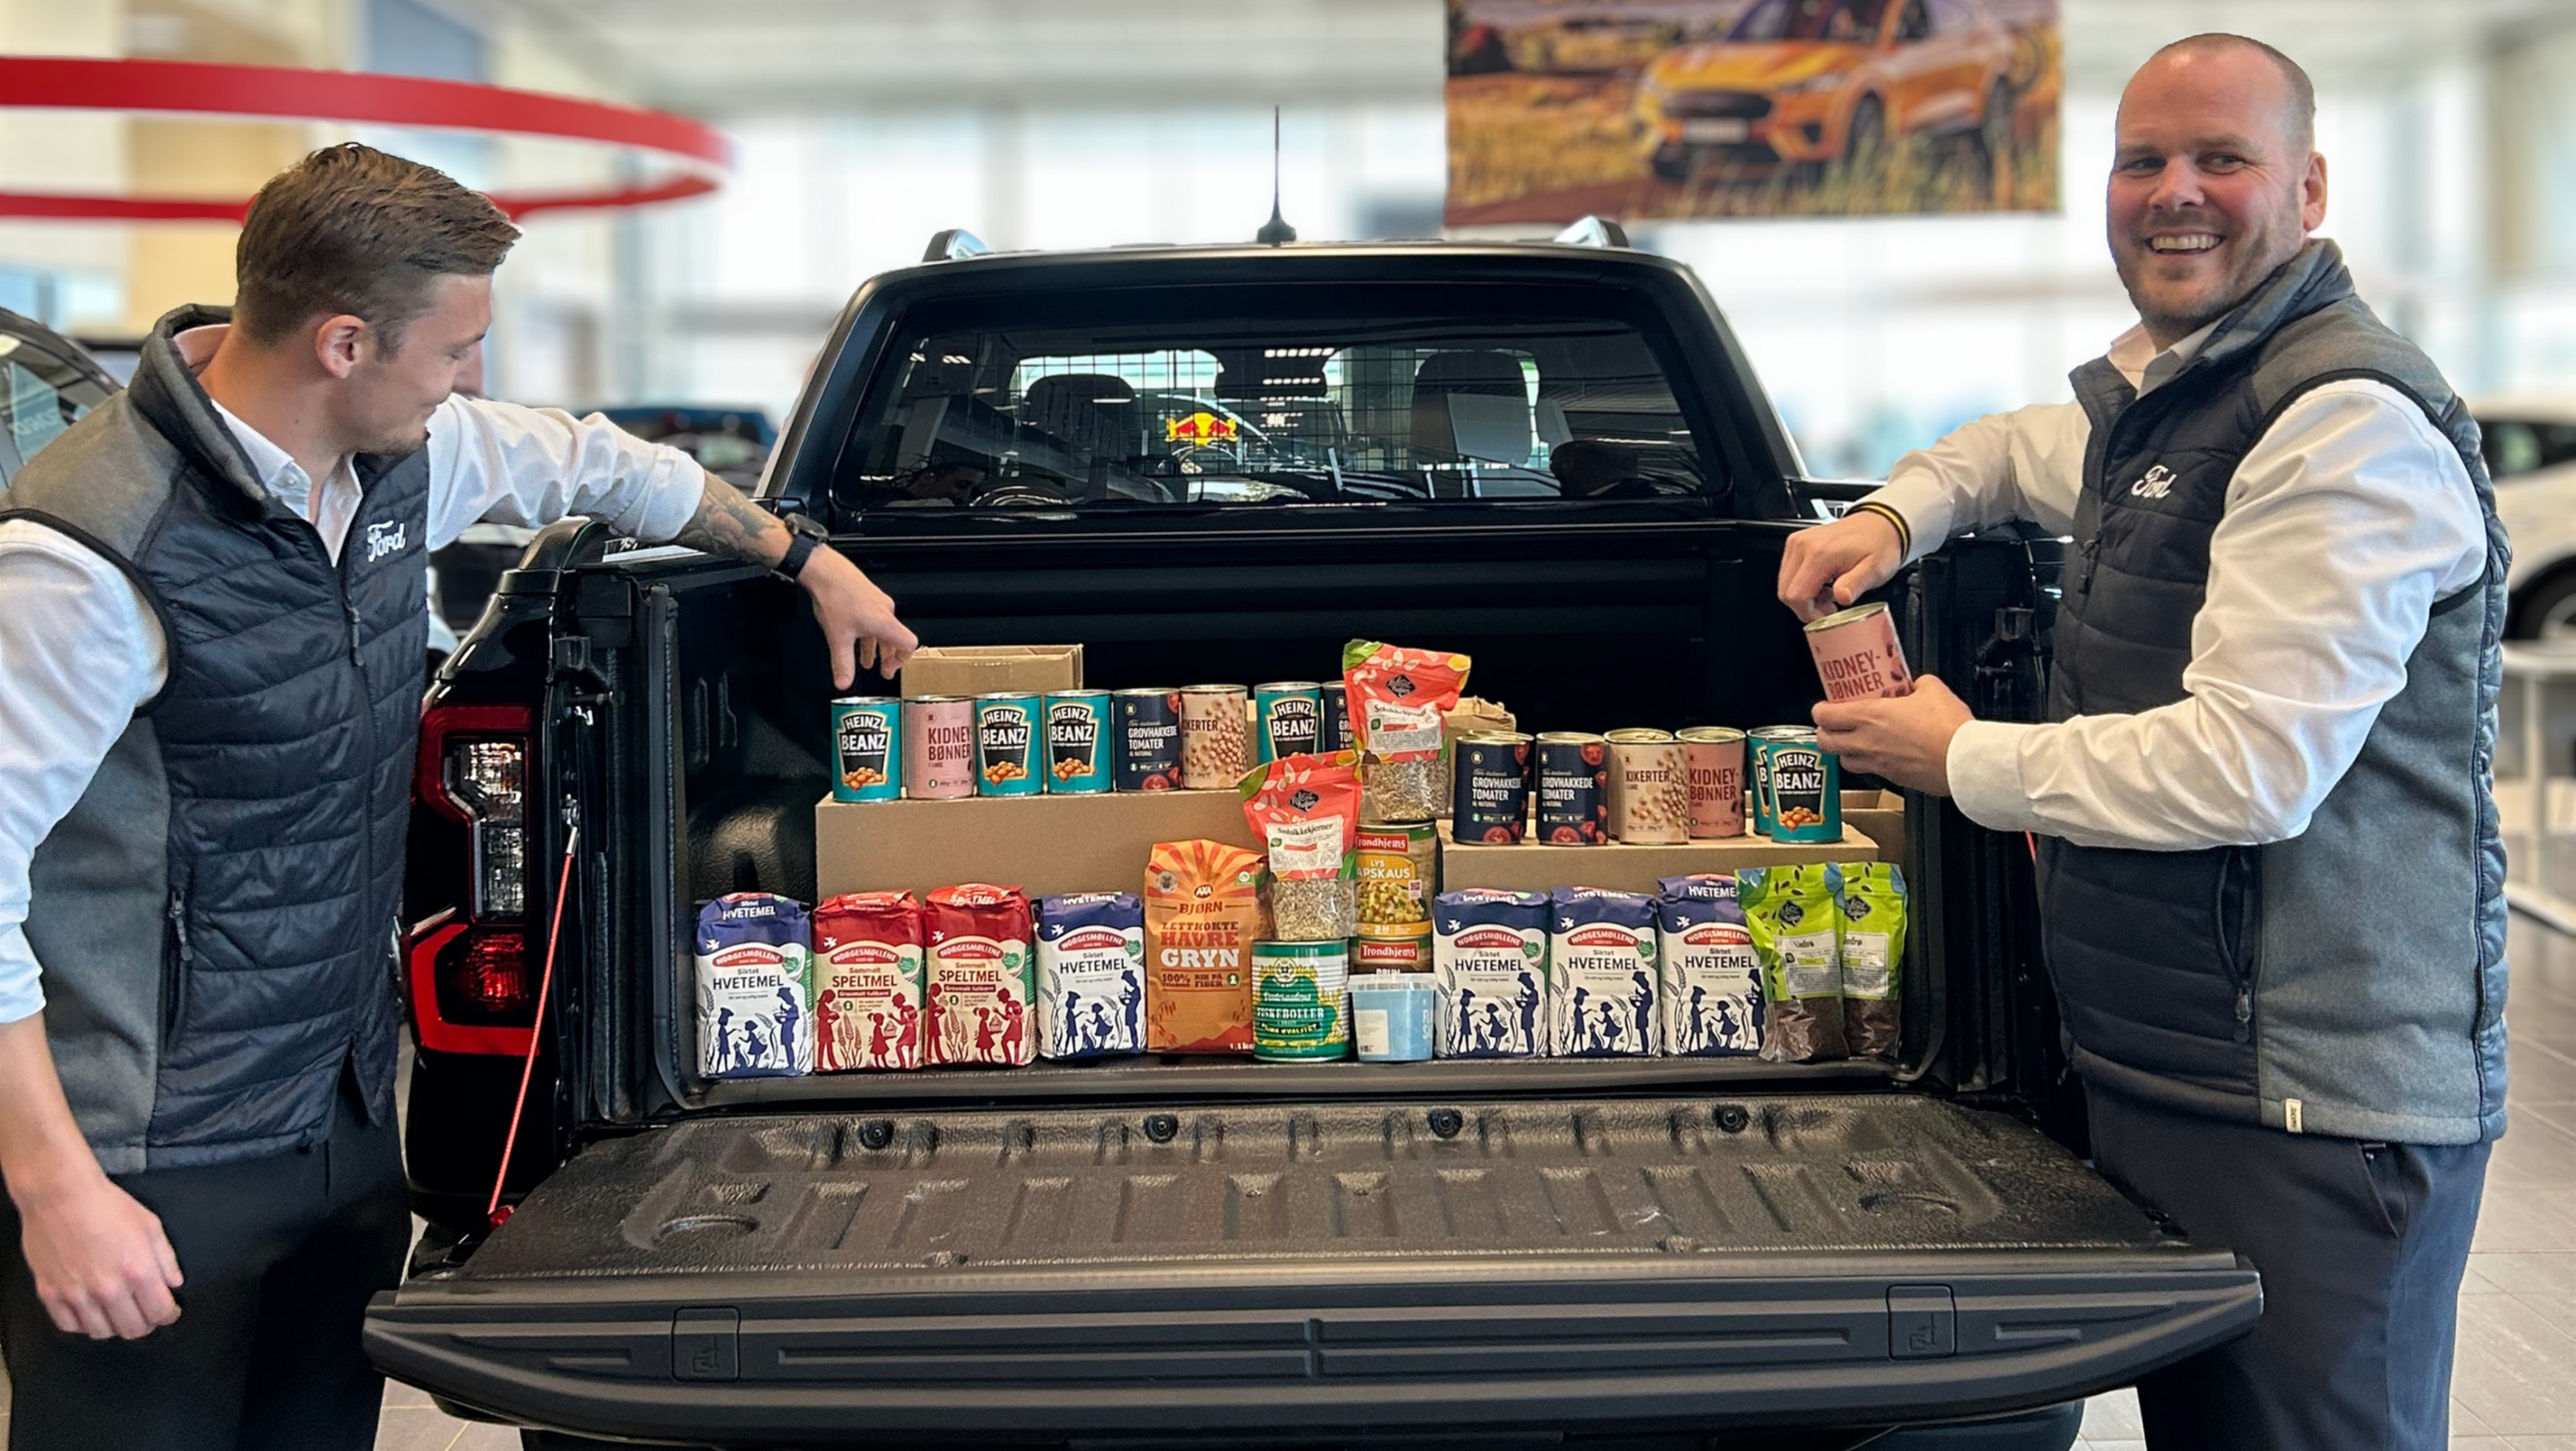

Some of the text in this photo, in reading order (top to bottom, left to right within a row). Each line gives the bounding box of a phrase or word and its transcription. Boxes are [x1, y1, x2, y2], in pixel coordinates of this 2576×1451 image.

[2131, 464, 2178, 498] Ford
[368, 520, 406, 562] Ford
[1054, 707, 1088, 721] HEINZ
[1276, 701, 1310, 716] HEINZ
[844, 715, 882, 730] HEINZ
[986, 710, 1021, 724] HEINZ
[1050, 725, 1093, 742] BEANZ
[1127, 725, 1177, 738] GROVHAKKEDE
[1272, 719, 1315, 736] BEANZ
[841, 733, 886, 750] BEANZ
[982, 727, 1026, 745] BEANZ
[1127, 738, 1164, 750] TOMATER
[928, 744, 970, 762] BØNNER
[1778, 753, 1815, 768] HEINZ
[1472, 776, 1522, 789] GROVHAKKEDE
[1542, 777, 1594, 789] GROVHAKKEDE
[1625, 769, 1670, 783] KIKERTER
[1776, 773, 1821, 789] BEANZ
[1472, 788, 1509, 800] TOMATER
[1542, 789, 1575, 800] TOMATER
[1689, 785, 1736, 801] BØNNER
[1370, 859, 1386, 868] LYS
[1357, 867, 1411, 879] APSKAUS
[1195, 885, 1212, 896] AXA
[1688, 885, 1737, 898] HVETEME
[722, 906, 775, 920] HVETEMEL
[1179, 901, 1223, 915] BJØRN
[1162, 921, 1238, 931] LETTKOKTE
[1060, 932, 1124, 950] NORGESMØLLENE
[1161, 932, 1238, 946] HAVRE
[1362, 944, 1416, 957] Trondhjems
[1161, 948, 1240, 968] GRYN
[1455, 958, 1524, 972] HVETEMEL
[1568, 956, 1639, 970] HVETEMEL
[1685, 956, 1754, 968] HVETEMEL
[1060, 958, 1127, 974] HVETEMEL
[713, 974, 785, 990] HVETEMEL
[831, 974, 898, 988] SPELTMEL
[939, 969, 1003, 982] SPELTMEL
[1163, 973, 1191, 983] 100%
[1257, 1007, 1324, 1019] FISKEBOLLER
